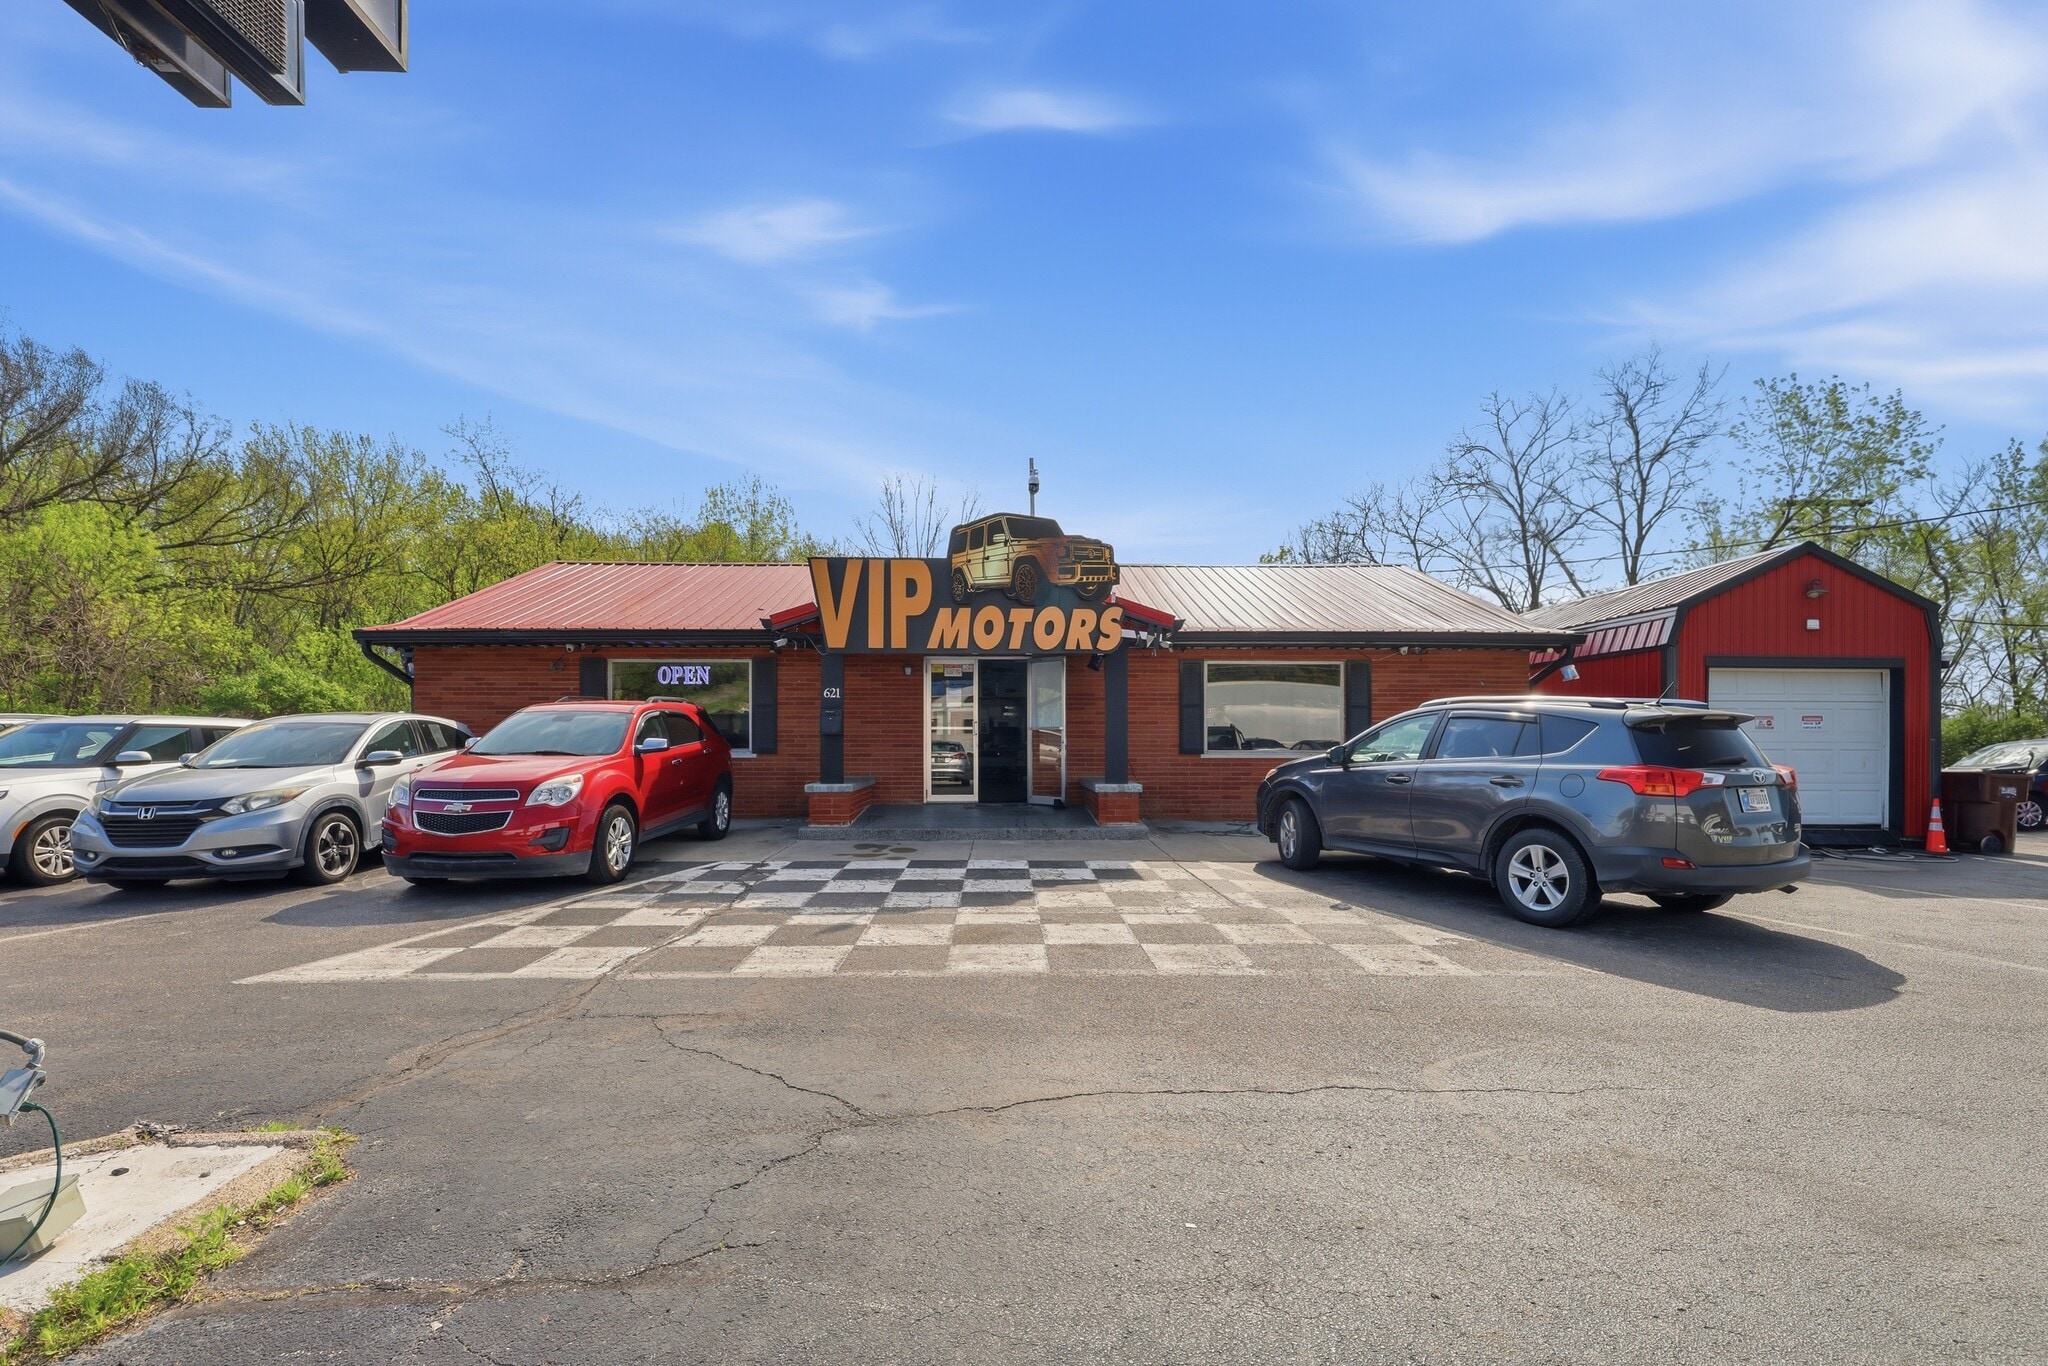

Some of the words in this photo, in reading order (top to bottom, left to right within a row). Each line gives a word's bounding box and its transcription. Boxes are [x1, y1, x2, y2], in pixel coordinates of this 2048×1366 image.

[810, 559, 932, 648] VIP
[926, 605, 1123, 650] MOTORS
[657, 665, 711, 685] OPEN
[823, 687, 841, 699] 621
